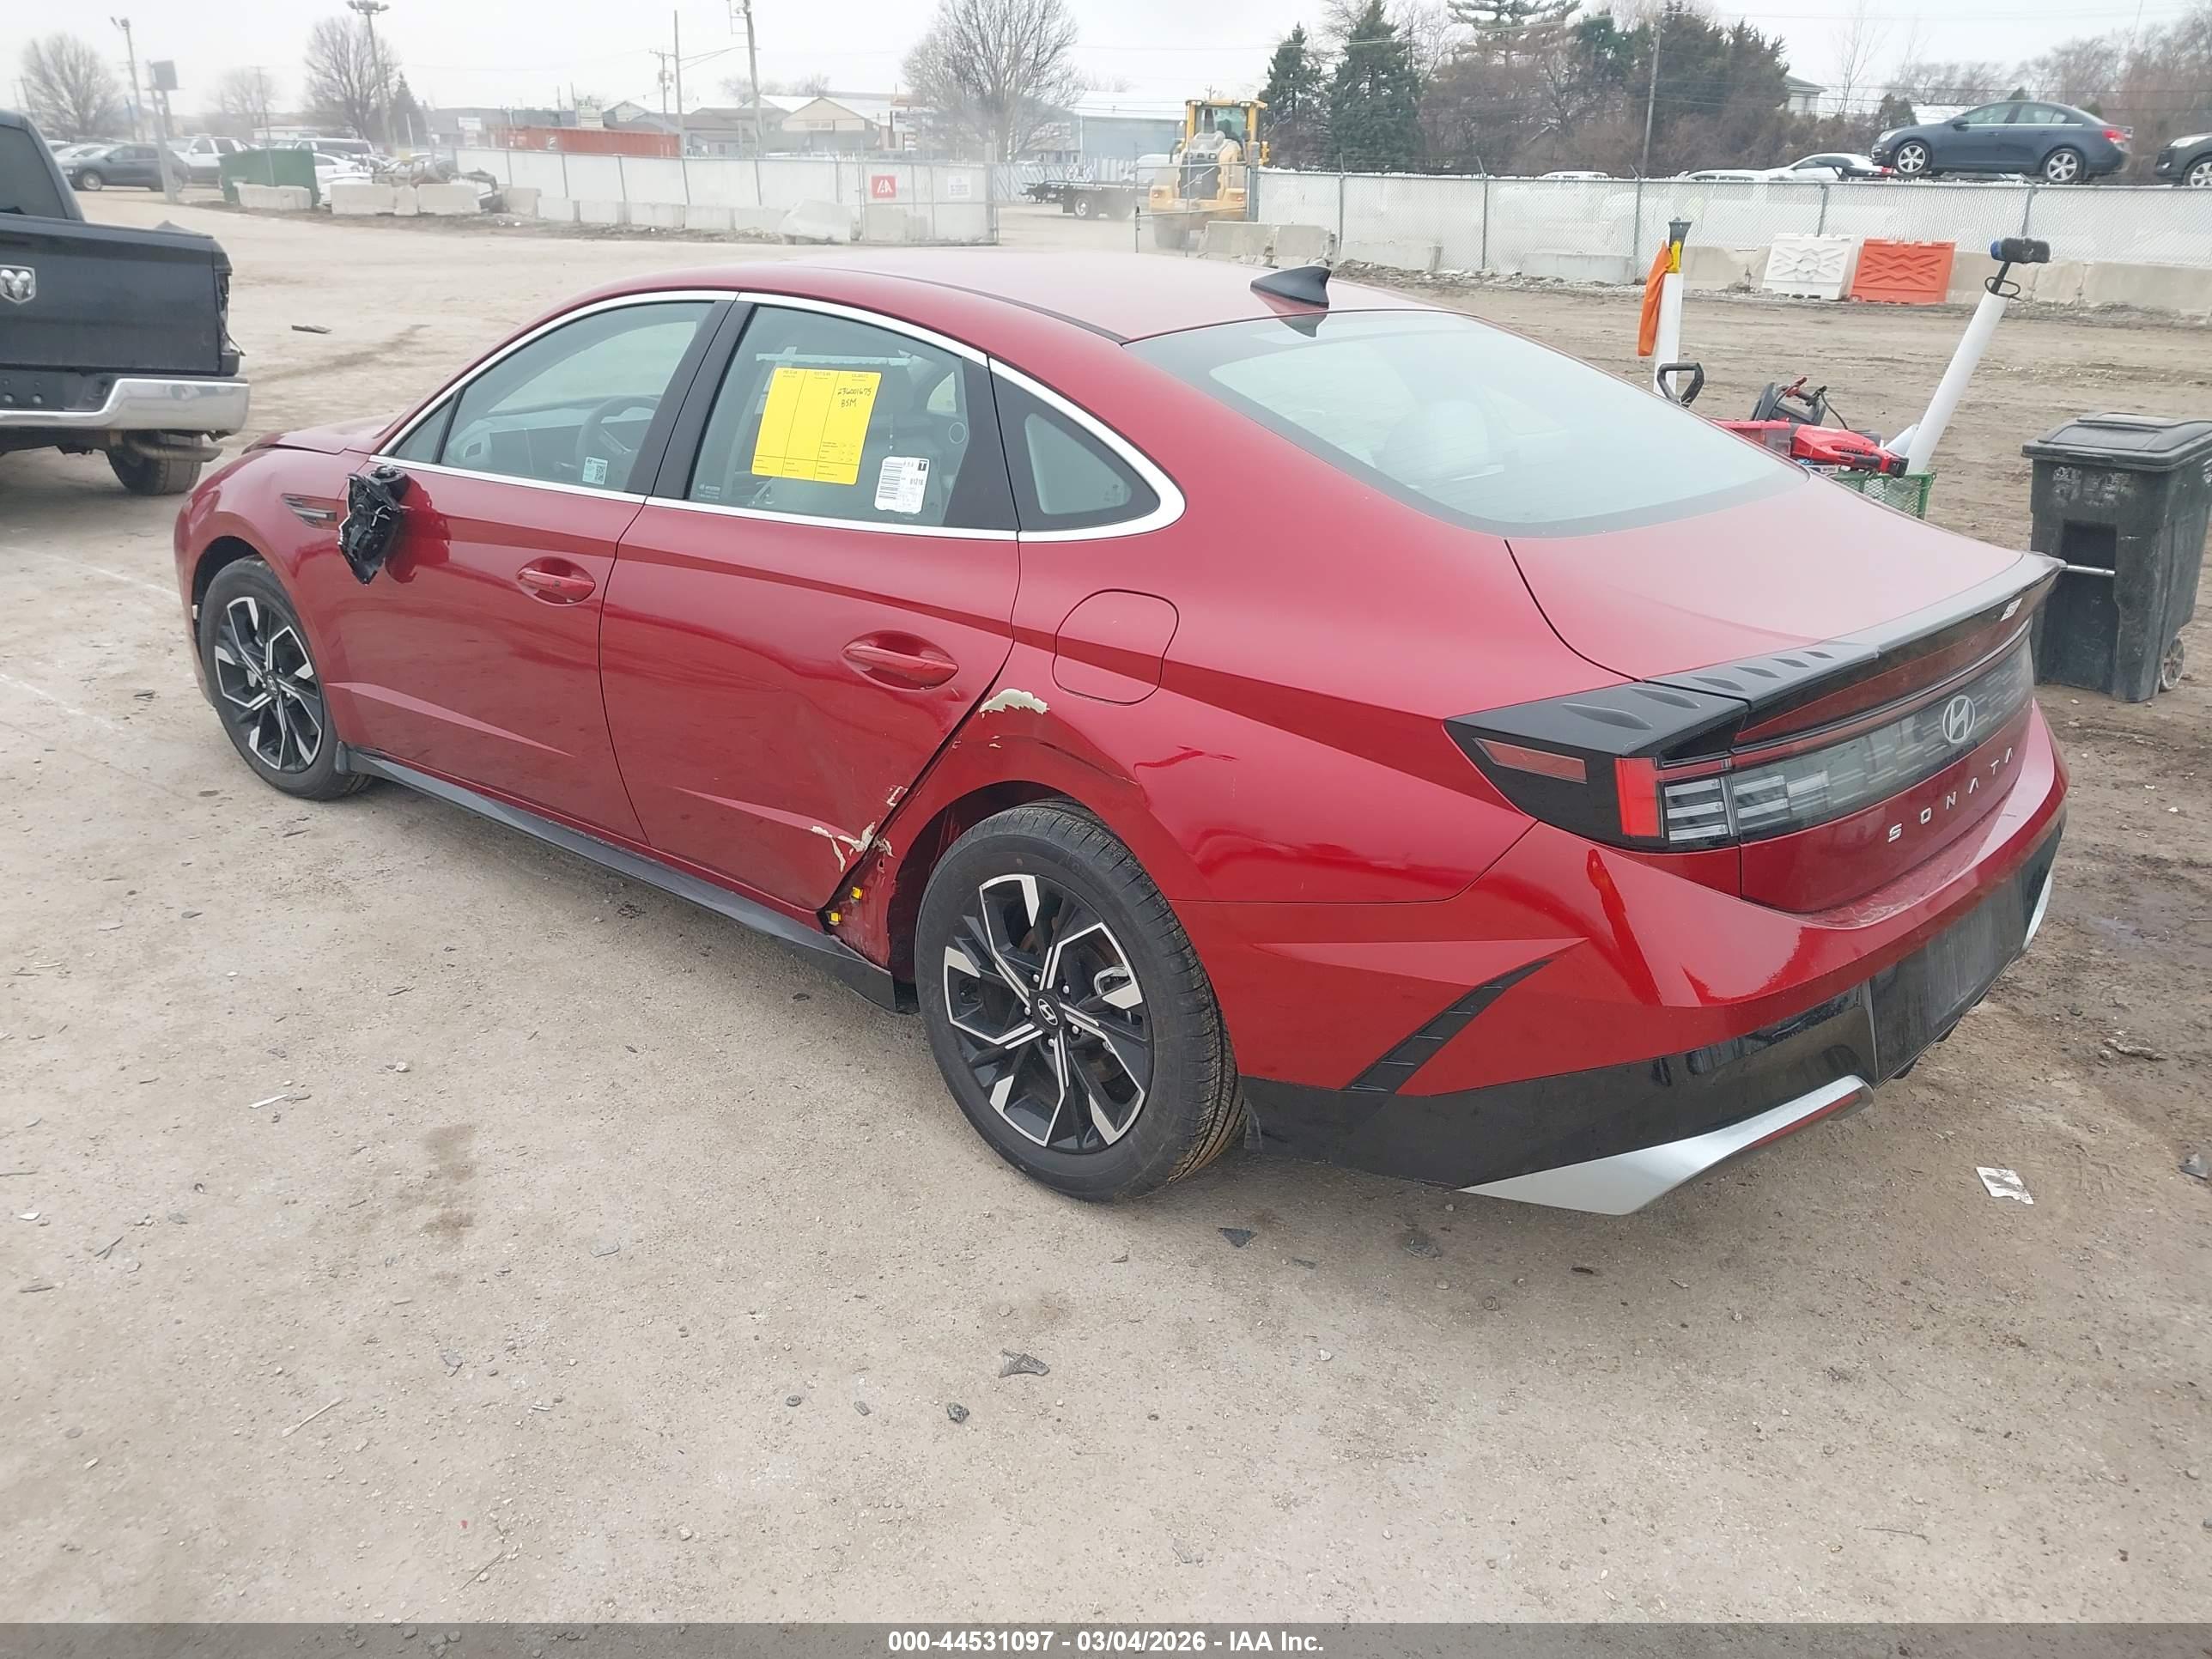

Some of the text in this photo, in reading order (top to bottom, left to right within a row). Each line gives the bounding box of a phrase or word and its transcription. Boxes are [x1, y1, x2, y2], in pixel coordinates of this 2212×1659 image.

[841, 398, 857, 408] BSM
[919, 460, 927, 470] T
[1887, 747, 2014, 842] SONATA
